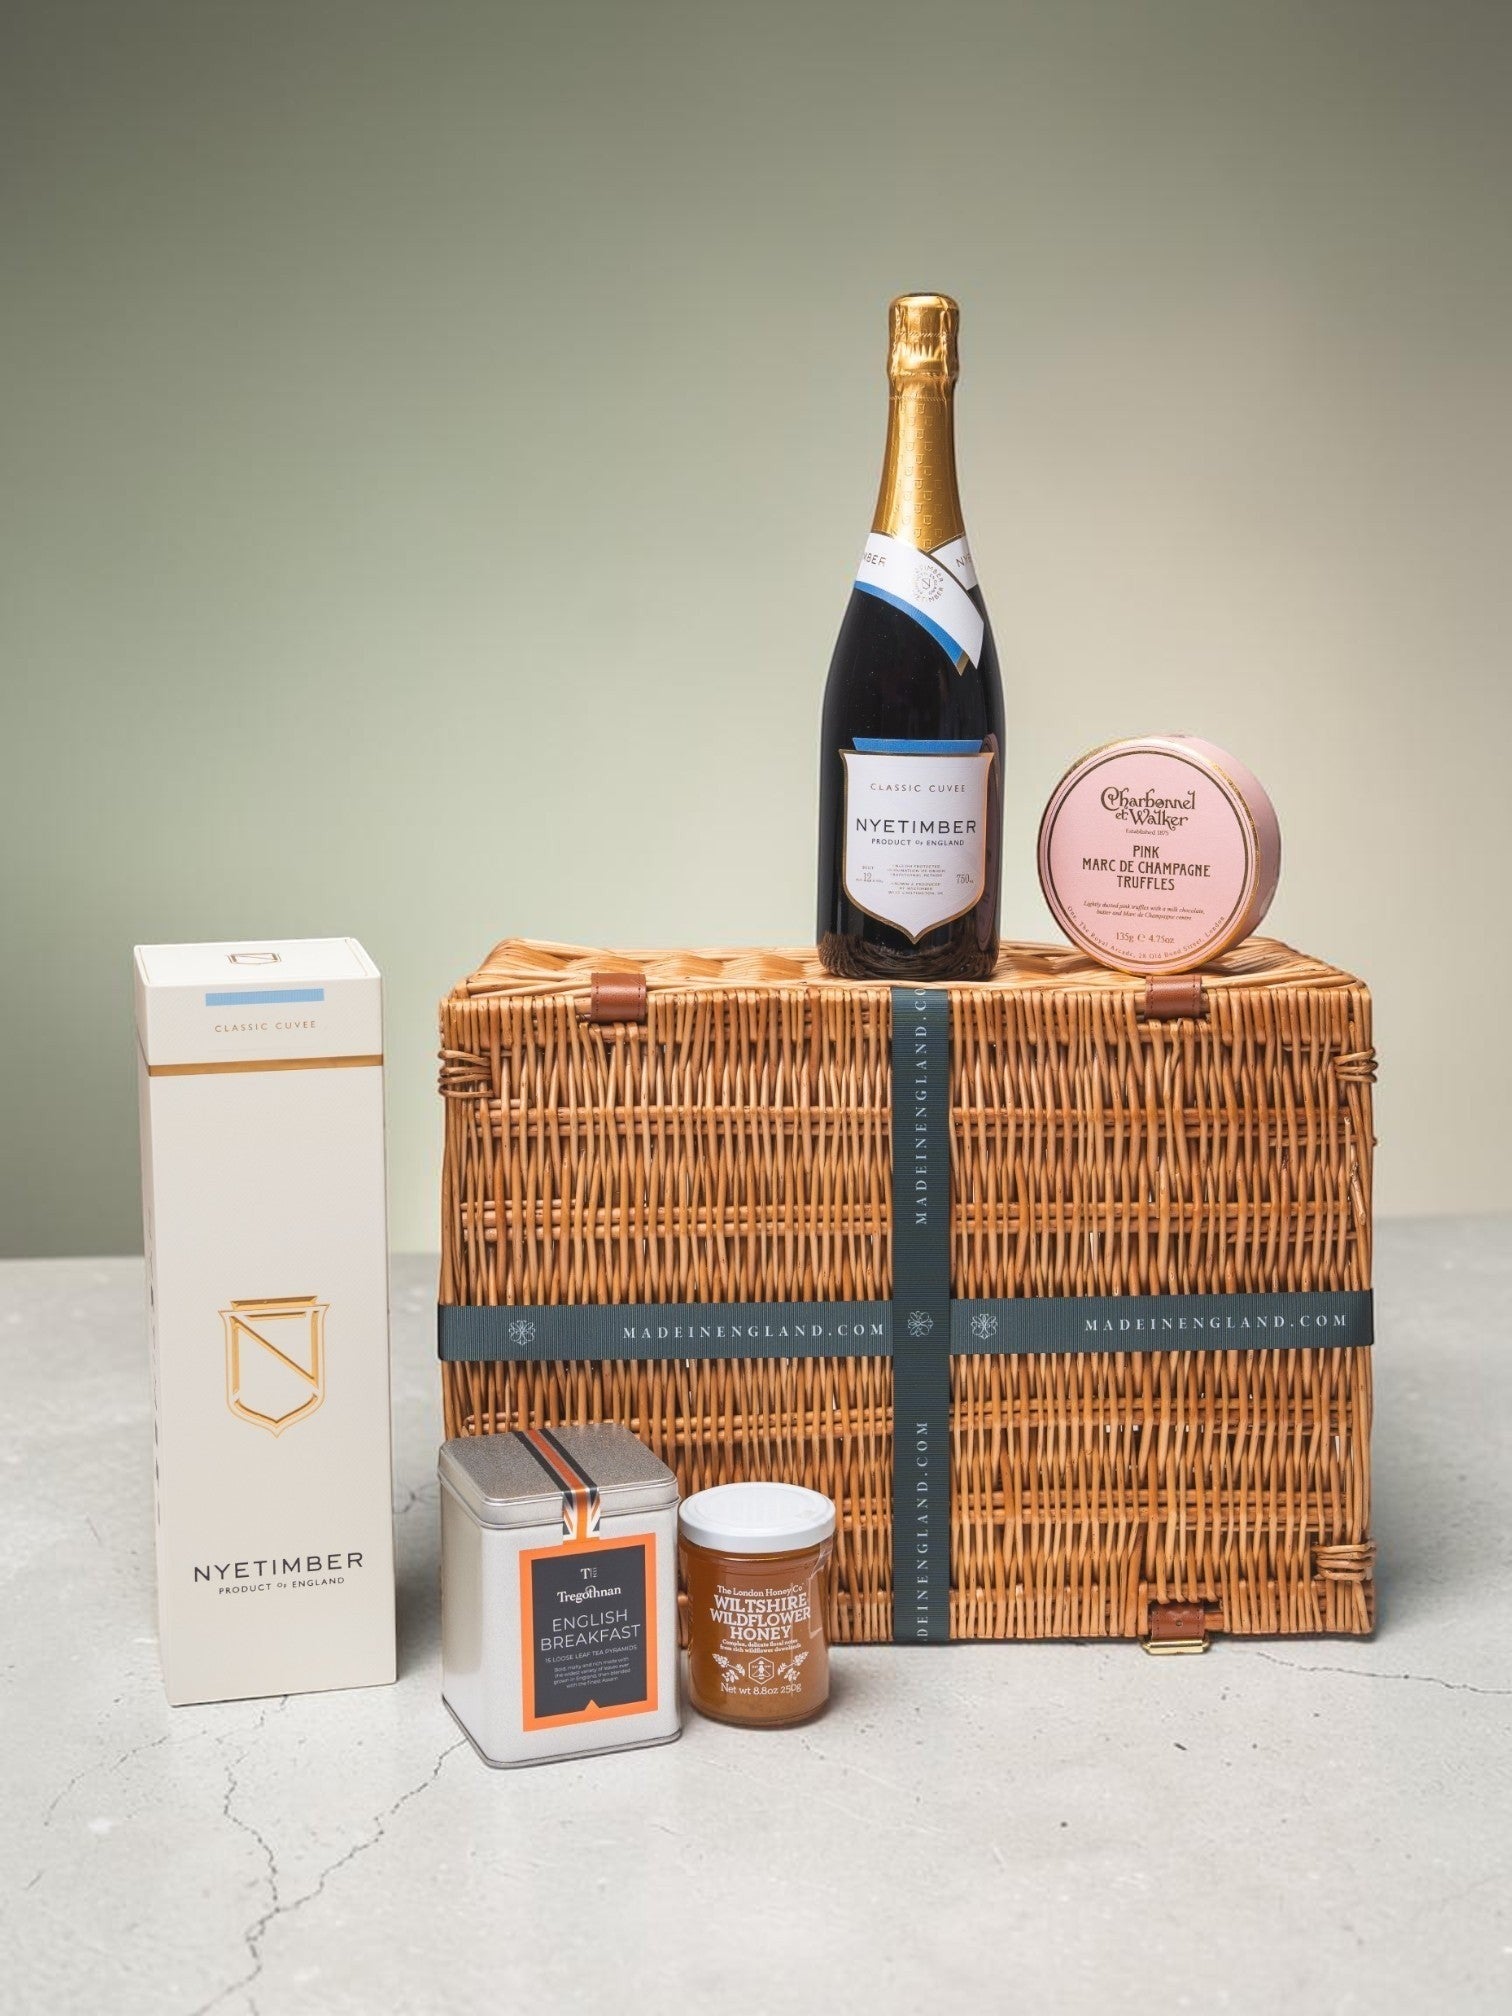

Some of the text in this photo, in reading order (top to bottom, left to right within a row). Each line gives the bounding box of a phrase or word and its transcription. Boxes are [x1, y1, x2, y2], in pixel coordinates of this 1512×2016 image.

[870, 783, 966, 793] CLASSIC CUVEE
[1101, 787, 1196, 811] Charbonnel
[856, 818, 977, 834] NYETIMBER
[1115, 808, 1189, 831] et Walker
[871, 838, 911, 846] PRODUCT
[1133, 845, 1160, 859] PINK
[1082, 858, 1211, 878] MARC DE CHAMPAGNE
[1117, 875, 1175, 891] TRUFFLES
[1145, 912, 1175, 920] Champagne
[1079, 922, 1089, 933] The
[1091, 931, 1109, 947] Royal
[1205, 916, 1225, 938] London
[1116, 931, 1134, 943] 135g
[1149, 934, 1175, 943] 4.75oz
[214, 1020, 317, 1033] CLASSIC CUVEE
[623, 1323, 885, 1340] MADEINENGLAND.COM
[1085, 1314, 1348, 1332] MADEINENGLAND.COM
[917, 1422, 929, 1639] DEINENGLAND.COM
[194, 1551, 364, 1583] NYETIMBER
[218, 1582, 272, 1595] PRODUCT
[292, 1577, 345, 1589] ENGLAND
[556, 1585, 622, 1604] Tregothnan
[717, 1585, 732, 1595] The
[733, 1587, 764, 1597] London
[765, 1587, 791, 1597] Honey
[713, 1592, 808, 1614] WILTSHIRE
[552, 1609, 628, 1632] ENGLISH
[710, 1606, 811, 1628] WILDFLOWER
[541, 1624, 641, 1652] BREAKFAST
[730, 1625, 792, 1641] HONEY
[552, 1654, 574, 1663] LOOSE
[575, 1652, 590, 1660] LEAF
[605, 1644, 638, 1654] PYRAMIDS
[610, 1668, 631, 1676] blended
[720, 1682, 802, 1695] Net wt 8.8oz 250g
